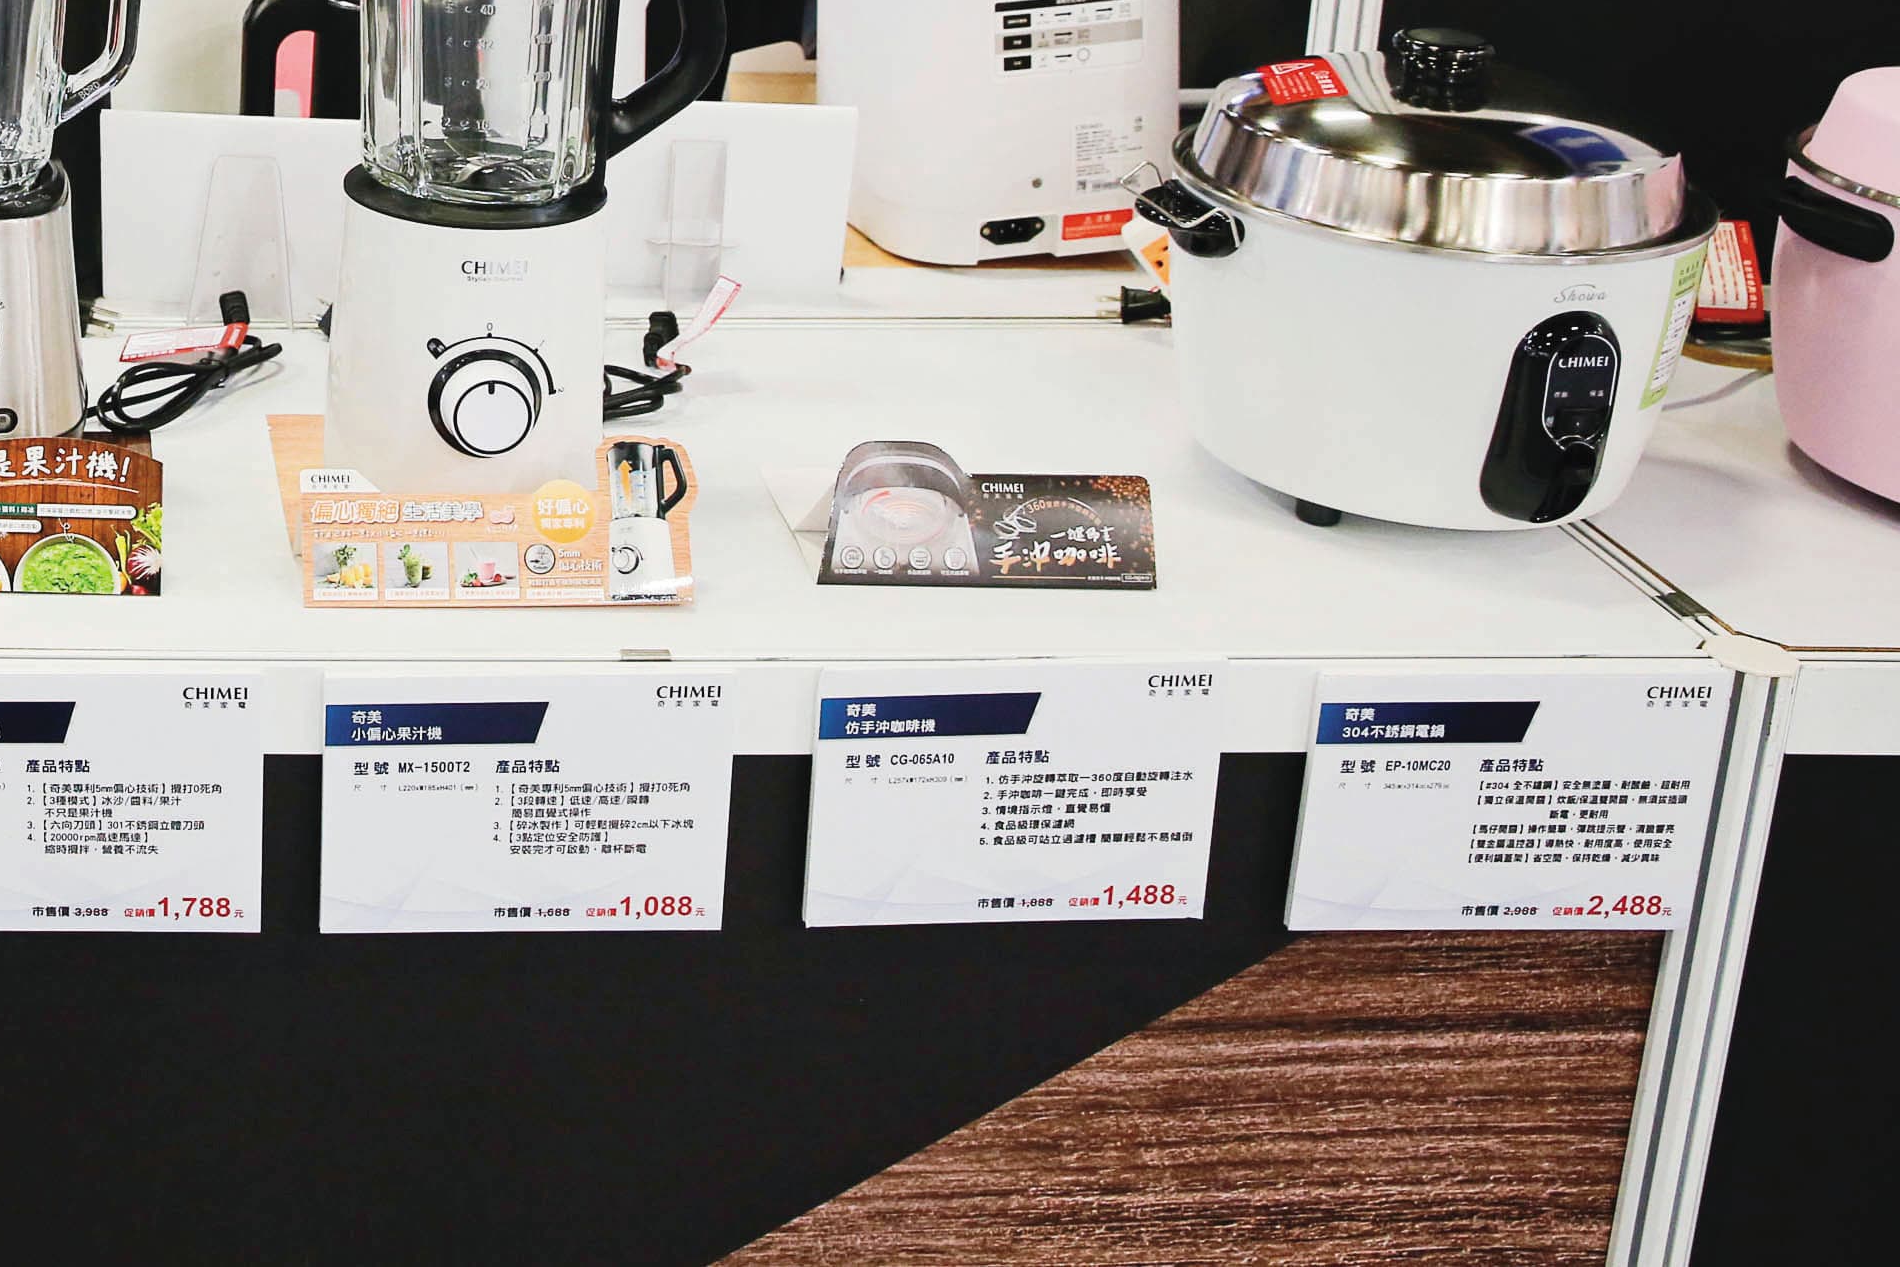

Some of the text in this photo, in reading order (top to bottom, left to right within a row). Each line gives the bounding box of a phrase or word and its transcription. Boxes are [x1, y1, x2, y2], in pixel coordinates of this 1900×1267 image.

[1558, 356, 1609, 369] CHIMEI
[310, 473, 351, 484] CHIMEI
[981, 482, 1025, 494] CHIMEI
[1148, 674, 1213, 689] CHIMEI
[182, 687, 249, 701] CHIMEI
[656, 685, 722, 700] CHIMEI
[1647, 686, 1713, 700] CHIMEI
[351, 710, 382, 725] 奇美
[846, 703, 877, 718] 奇美
[1345, 708, 1376, 722] 奇美
[351, 726, 443, 742] 小偏心果汁機
[845, 718, 936, 736] 仿手沖咖啡機
[845, 752, 956, 770] 型號 CG-065A10
[985, 750, 1051, 765] 產品特點
[25, 759, 91, 773] 產品特點
[353, 761, 471, 776] 型號 MX-1500T2
[495, 759, 560, 774] 產品特點
[1340, 759, 1451, 774] 型號 EP-10MC20
[1479, 758, 1544, 773] 產品特點
[44, 808, 113, 818] 不只是果汁機
[977, 897, 1015, 909] 市售價
[1103, 884, 1175, 909] 1,488
[1178, 895, 1188, 905] 元
[32, 906, 70, 918] 市售價
[157, 897, 231, 921] 1,788
[234, 908, 245, 918] 元
[494, 906, 532, 918] 市售價
[620, 896, 693, 920] 1,088
[695, 907, 706, 917] 元
[1461, 905, 1499, 917] 市售價
[1586, 895, 1662, 920] 2,488
[1662, 906, 1673, 917] 元
